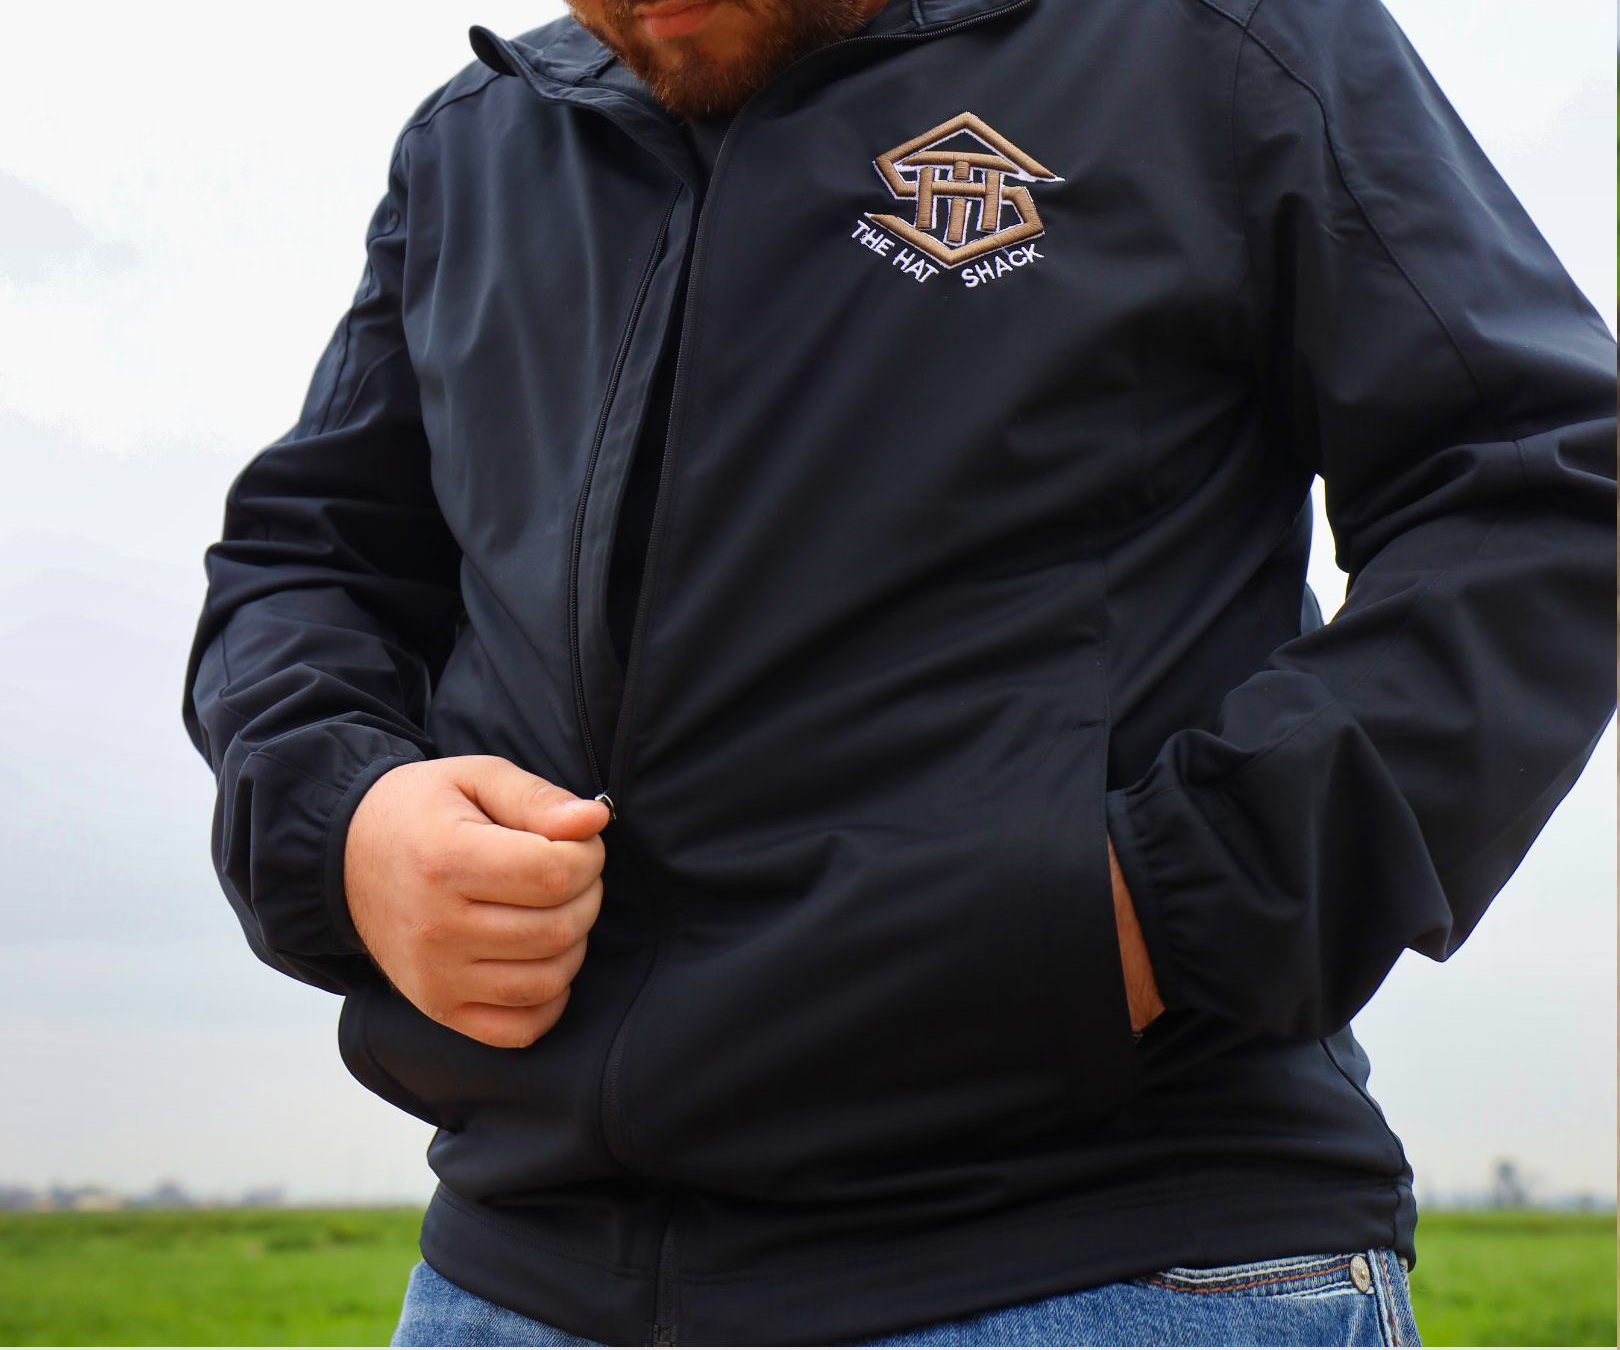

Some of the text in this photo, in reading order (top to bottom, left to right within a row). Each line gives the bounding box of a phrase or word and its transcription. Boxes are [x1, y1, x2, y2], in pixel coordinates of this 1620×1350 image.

[851, 219, 1045, 288] THE HAT SHACK
